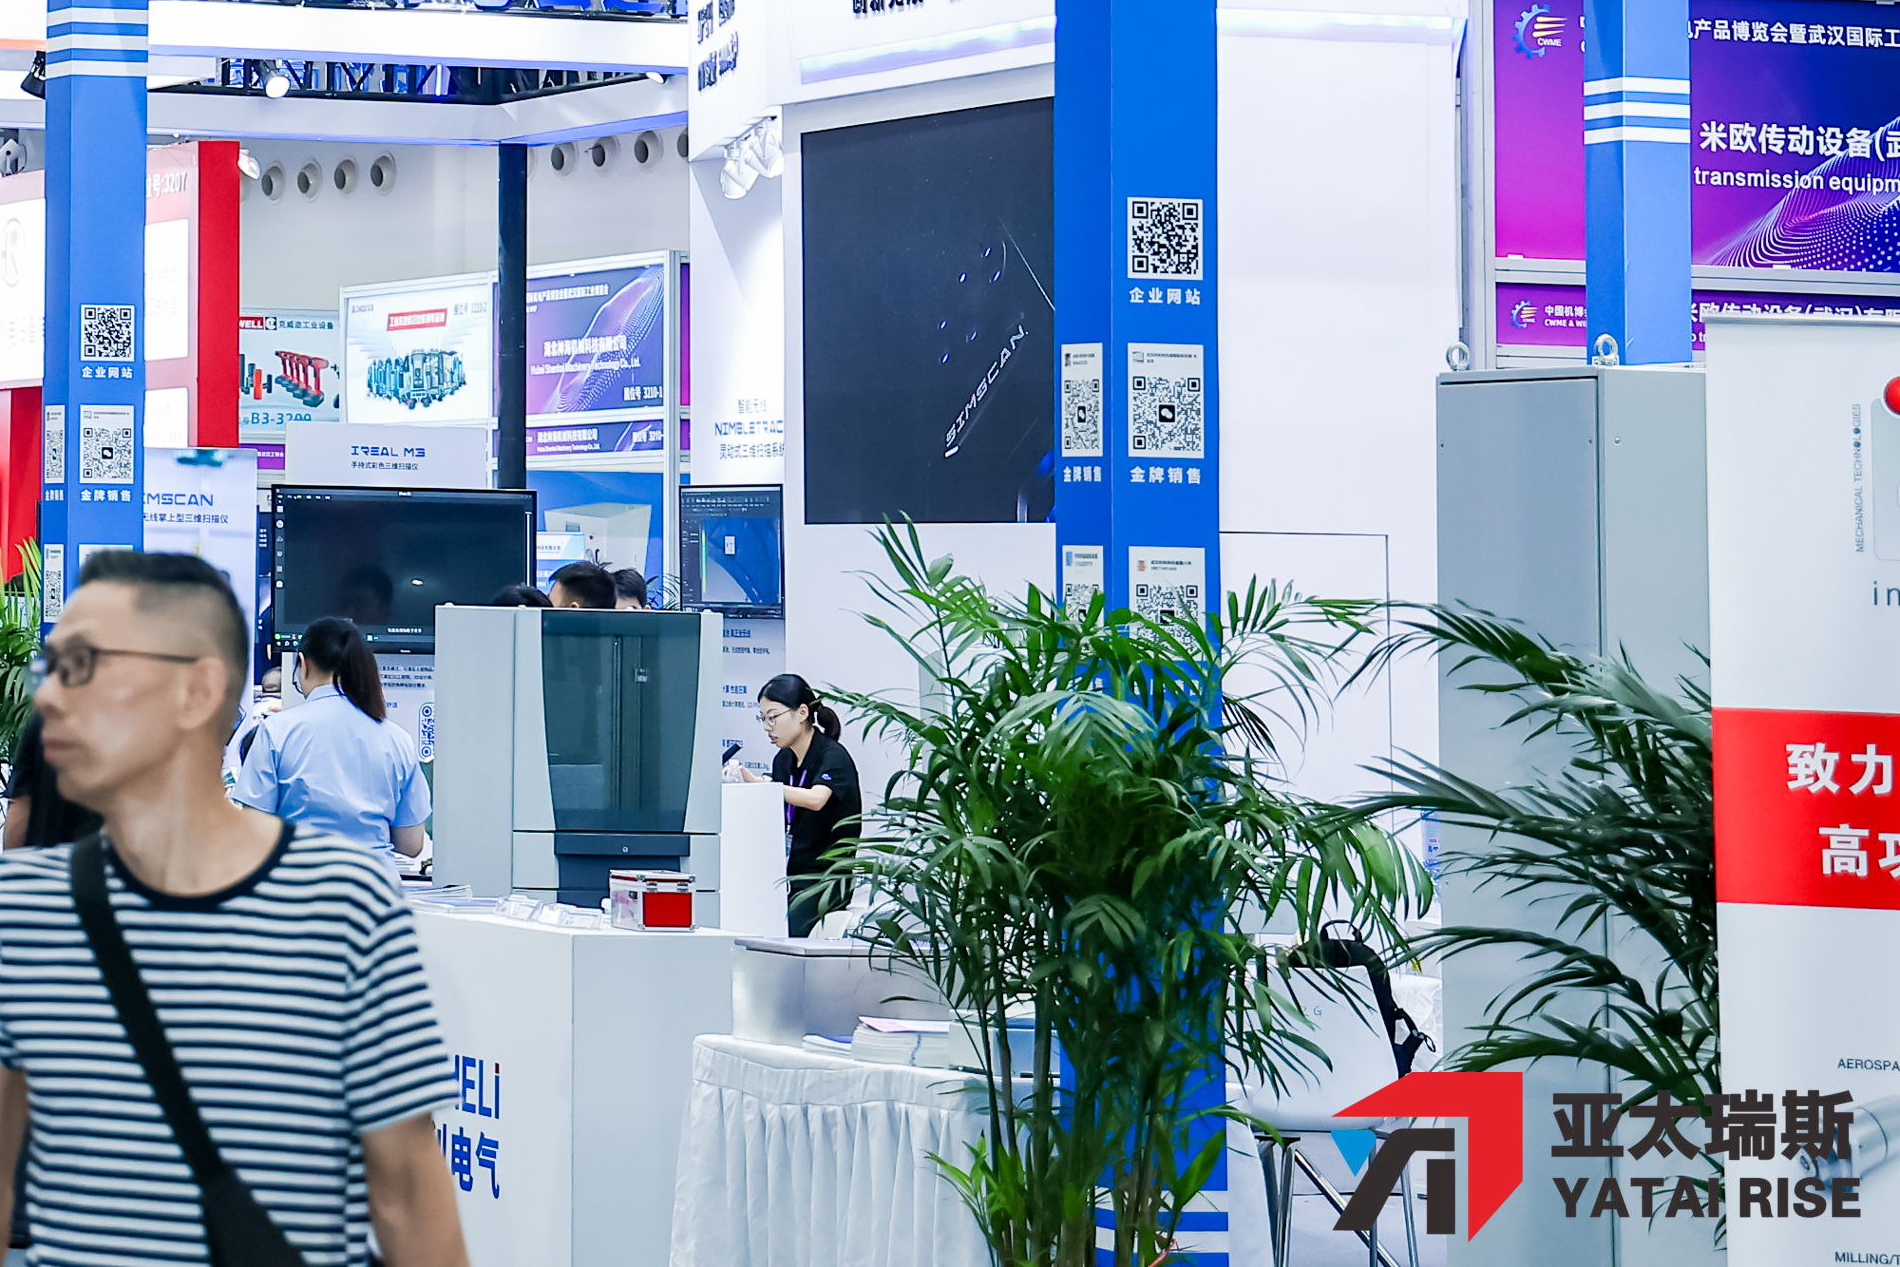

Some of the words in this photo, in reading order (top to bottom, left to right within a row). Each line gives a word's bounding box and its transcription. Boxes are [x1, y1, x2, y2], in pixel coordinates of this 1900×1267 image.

[1537, 36, 1562, 48] CWME
[1690, 18, 1900, 48] 产品博览会暨武汉国际工
[1693, 166, 1825, 191] transmission
[1128, 287, 1202, 305] 企业网站
[1544, 305, 1587, 317] 中国机博
[1544, 318, 1567, 326] CWME
[81, 366, 133, 379] 企业网站
[623, 387, 642, 401] 展位号
[945, 324, 1029, 447] SIMSCAN
[351, 446, 399, 457] IREAL
[404, 447, 426, 458] M3
[1849, 403, 1862, 483] TECHNOLOGIES
[351, 461, 419, 471] 手持式彩色三维扫描仪
[1063, 466, 1102, 484] 金牌销售
[1130, 466, 1202, 485] 金牌销售
[80, 489, 132, 502] 金牌销售
[1852, 486, 1864, 553] MECHANICAL
[1786, 742, 1893, 796] 致力
